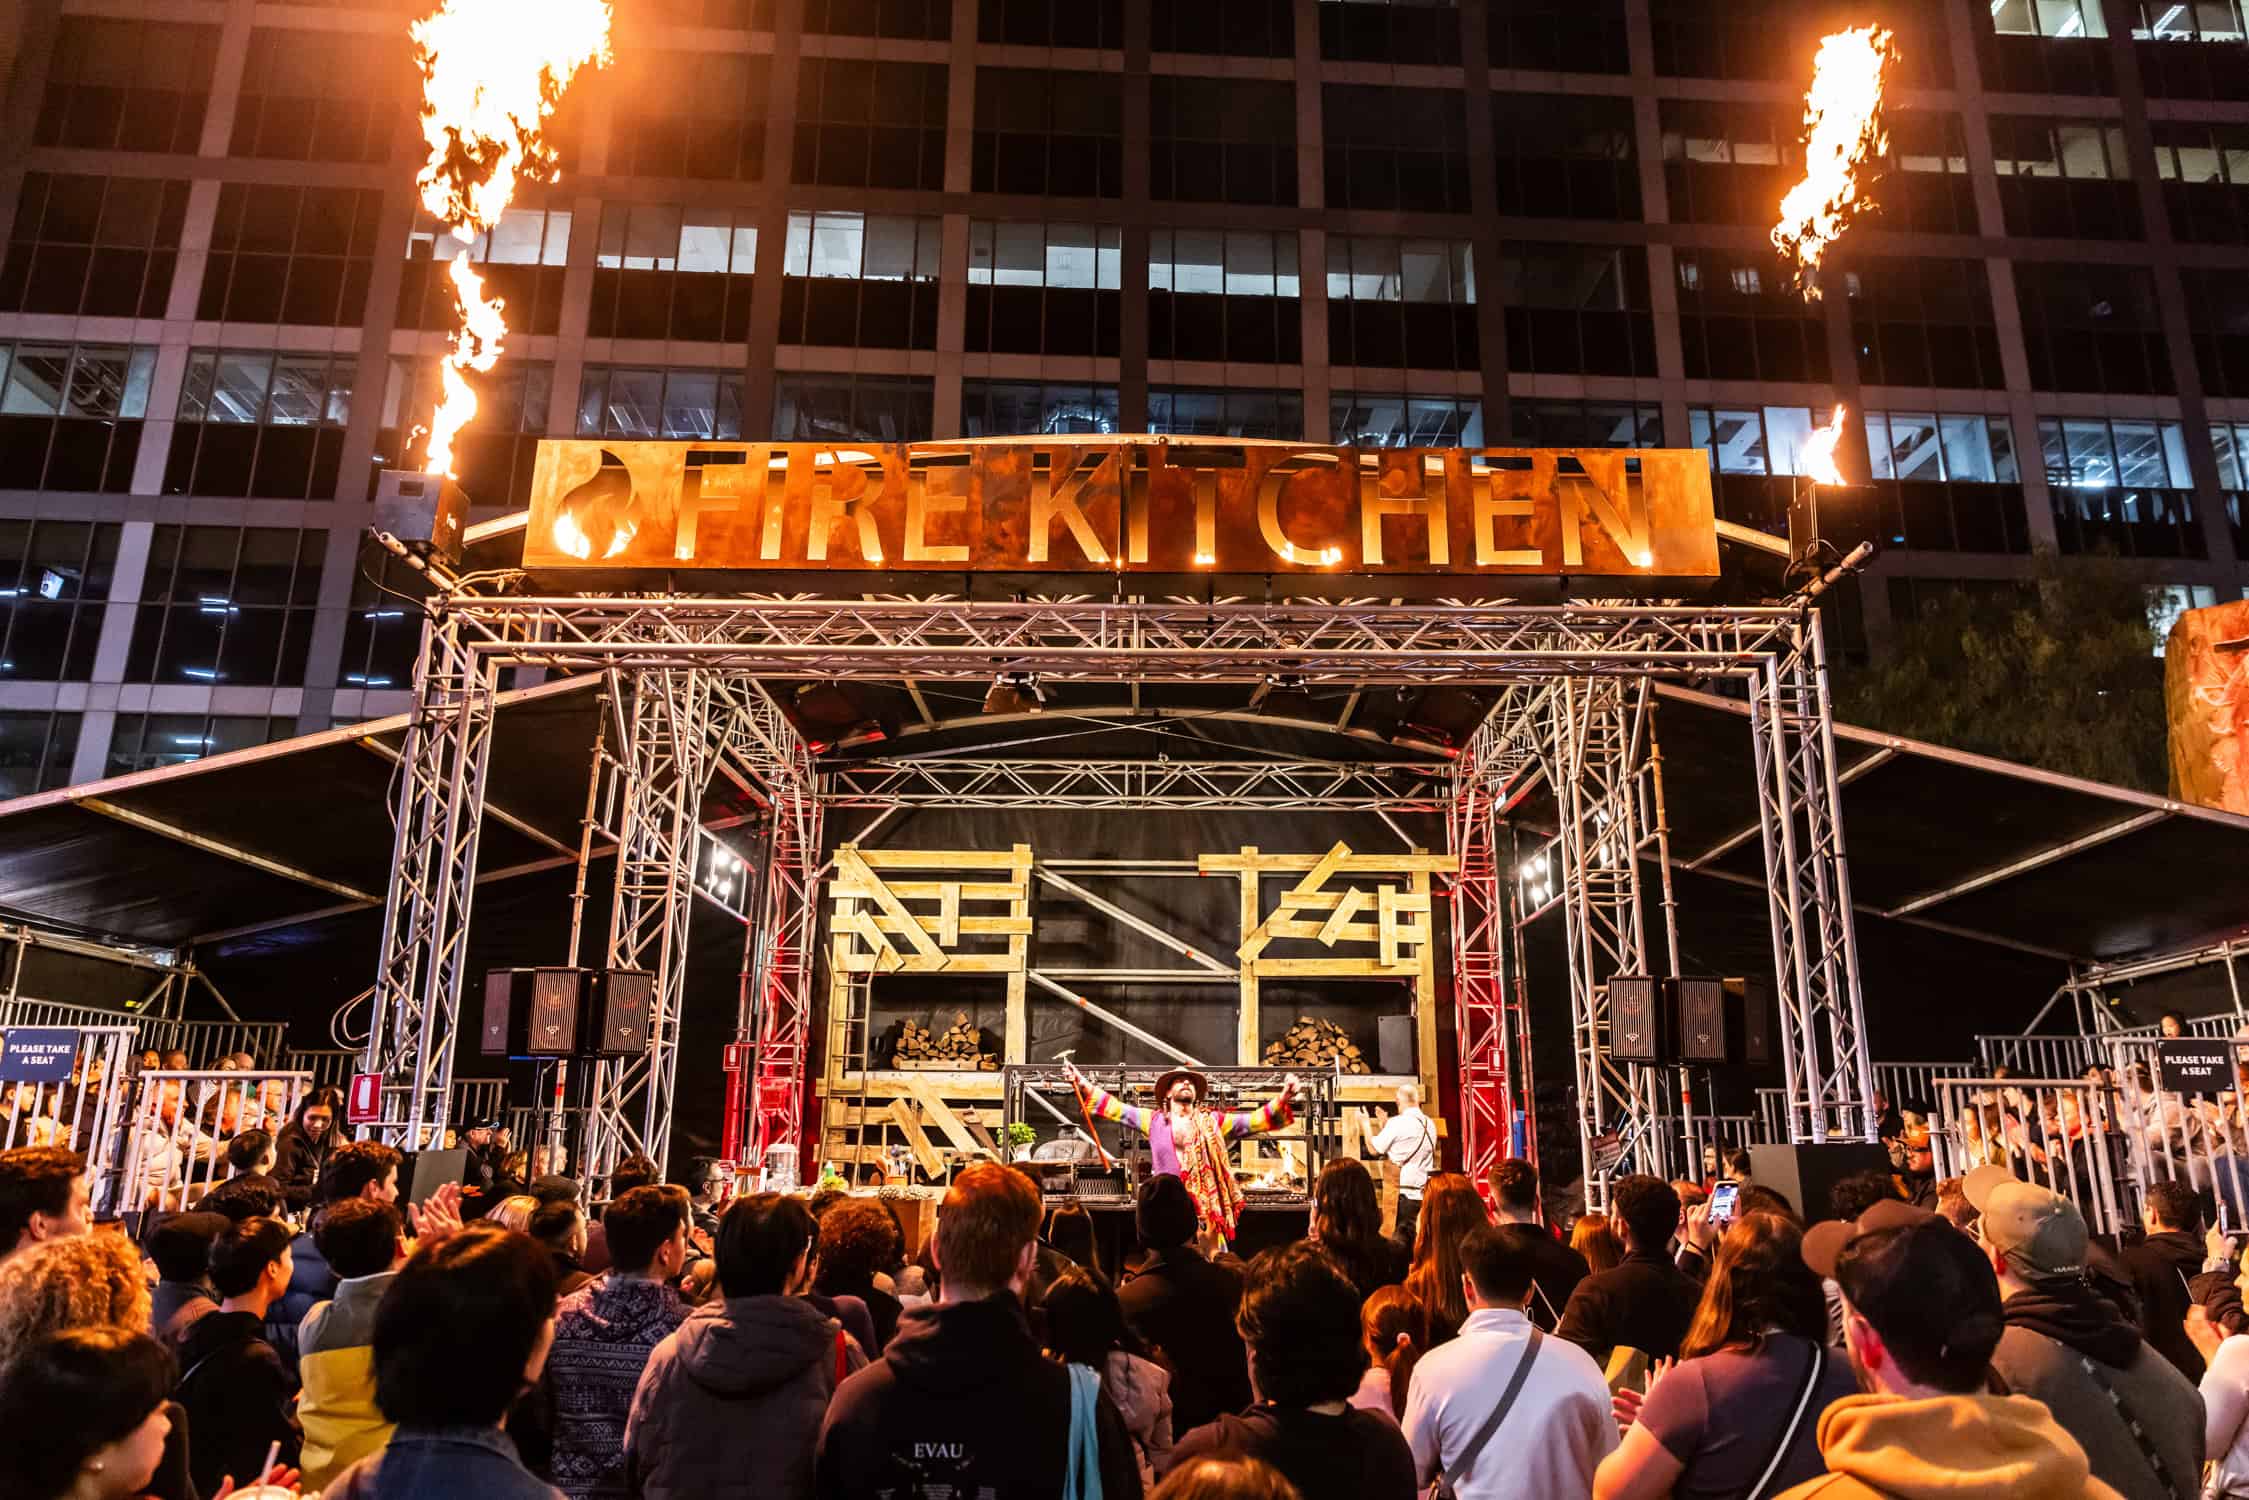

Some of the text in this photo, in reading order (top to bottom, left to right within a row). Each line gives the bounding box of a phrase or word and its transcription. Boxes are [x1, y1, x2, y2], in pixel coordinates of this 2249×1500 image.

[674, 450, 1653, 567] FIRE KITCHEN
[9, 1044, 71, 1054] PLEASE TAKE
[21, 1055, 55, 1065] A SEAT
[2164, 1055, 2225, 1065] PLEASE TAKE
[2181, 1066, 2212, 1076] A SEAT
[914, 1442, 964, 1458] EVAU
